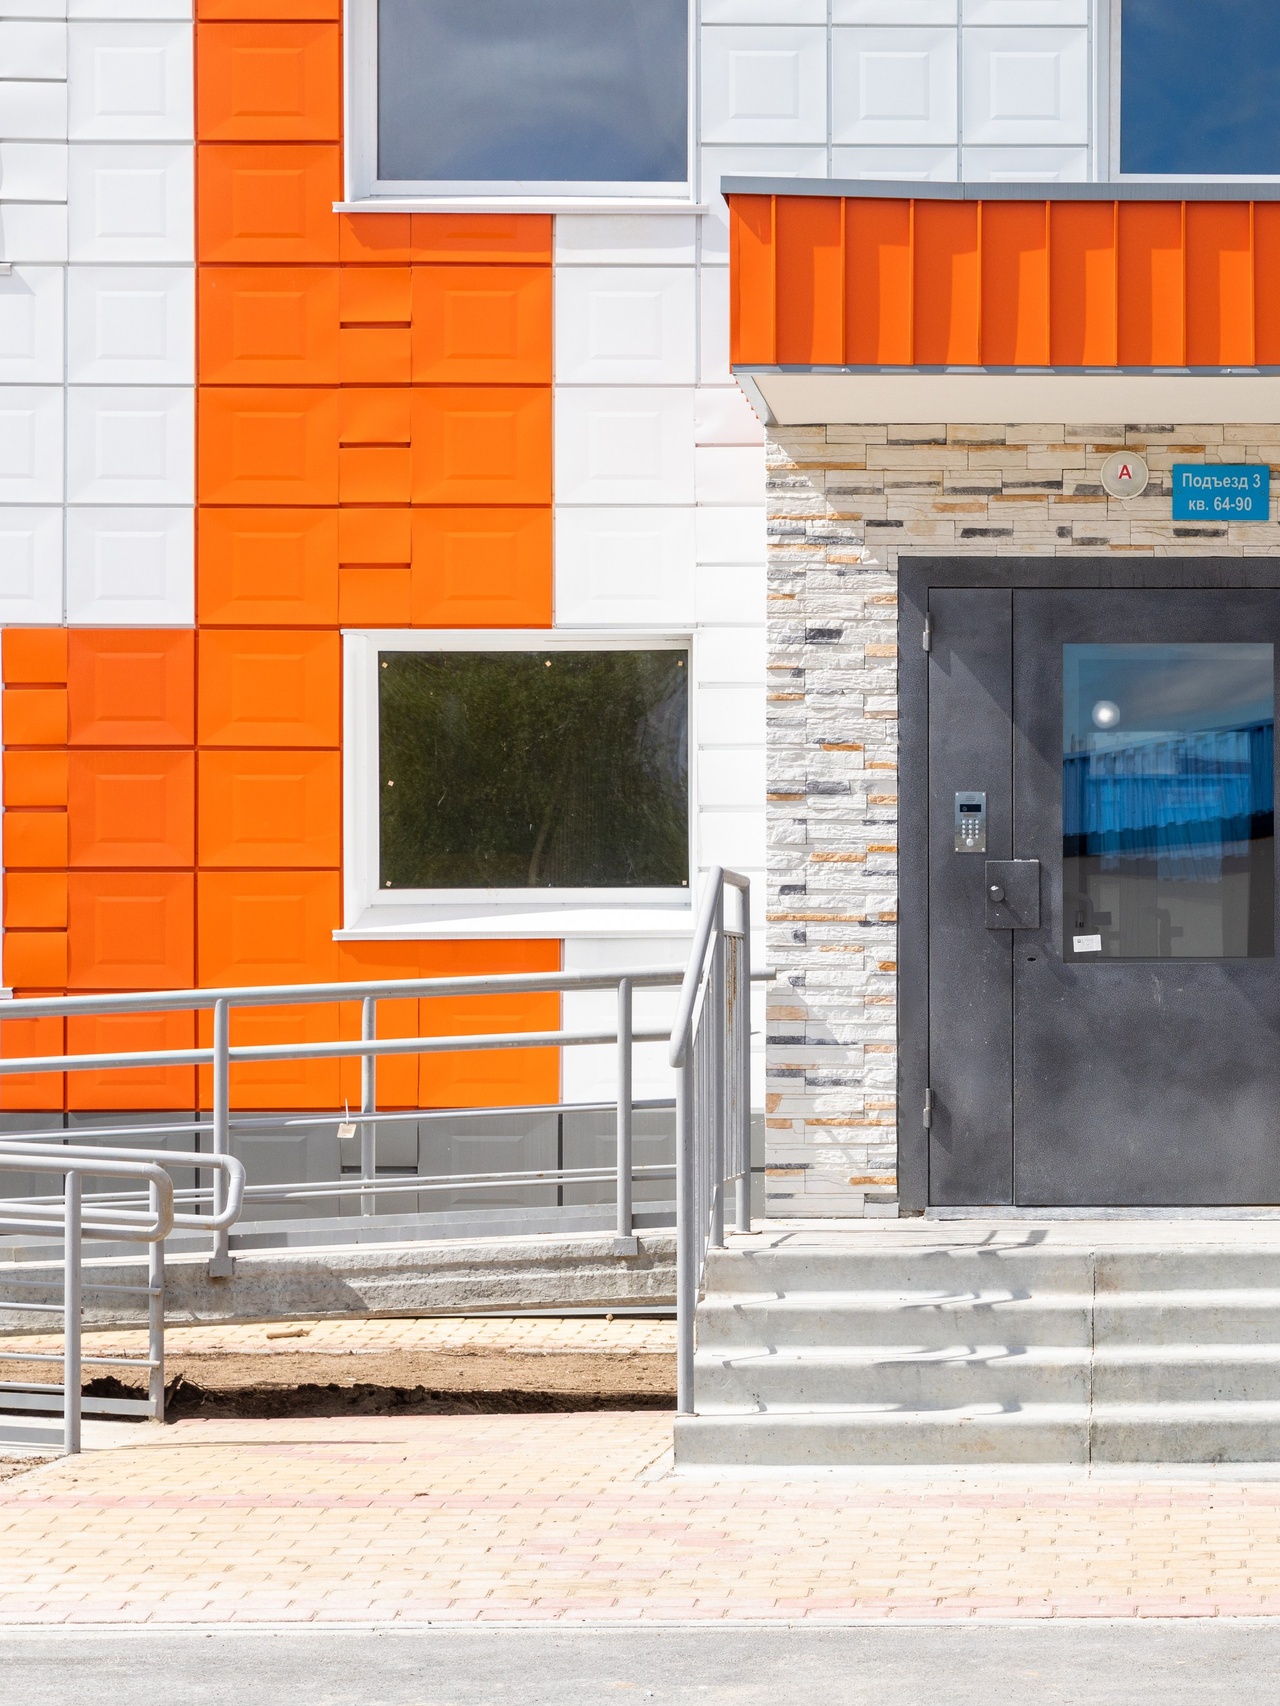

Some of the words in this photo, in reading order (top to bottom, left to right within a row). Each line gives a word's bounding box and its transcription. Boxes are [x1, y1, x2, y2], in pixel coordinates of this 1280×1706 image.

[1182, 473, 1248, 489] Подъезд
[1253, 473, 1261, 488] 3
[1188, 499, 1209, 511] кв.
[1213, 497, 1252, 511] 64-90
